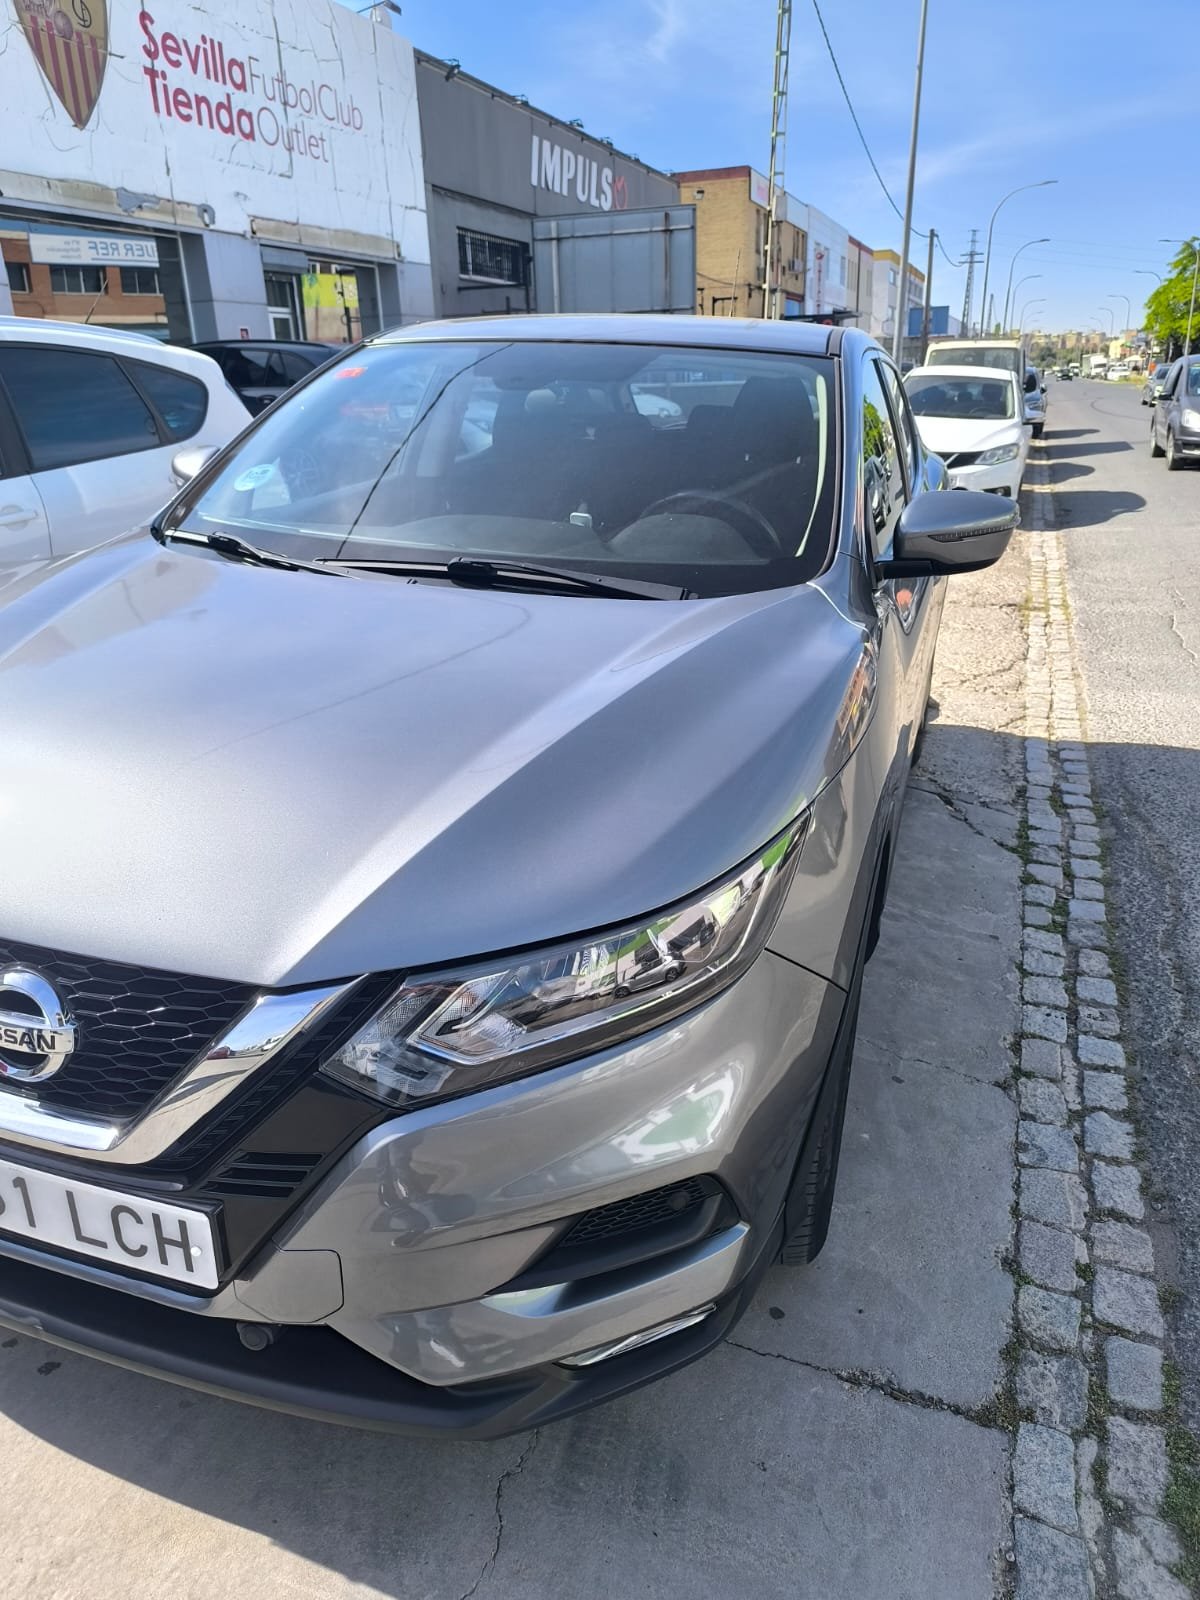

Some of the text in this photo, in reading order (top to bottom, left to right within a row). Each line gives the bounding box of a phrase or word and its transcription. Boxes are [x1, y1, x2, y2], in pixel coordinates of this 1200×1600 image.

[139, 10, 247, 92] Sevilla
[143, 65, 328, 163] Tienda Outlet
[0, 1026, 55, 1051] SAN
[66, 1190, 194, 1273] LCH
